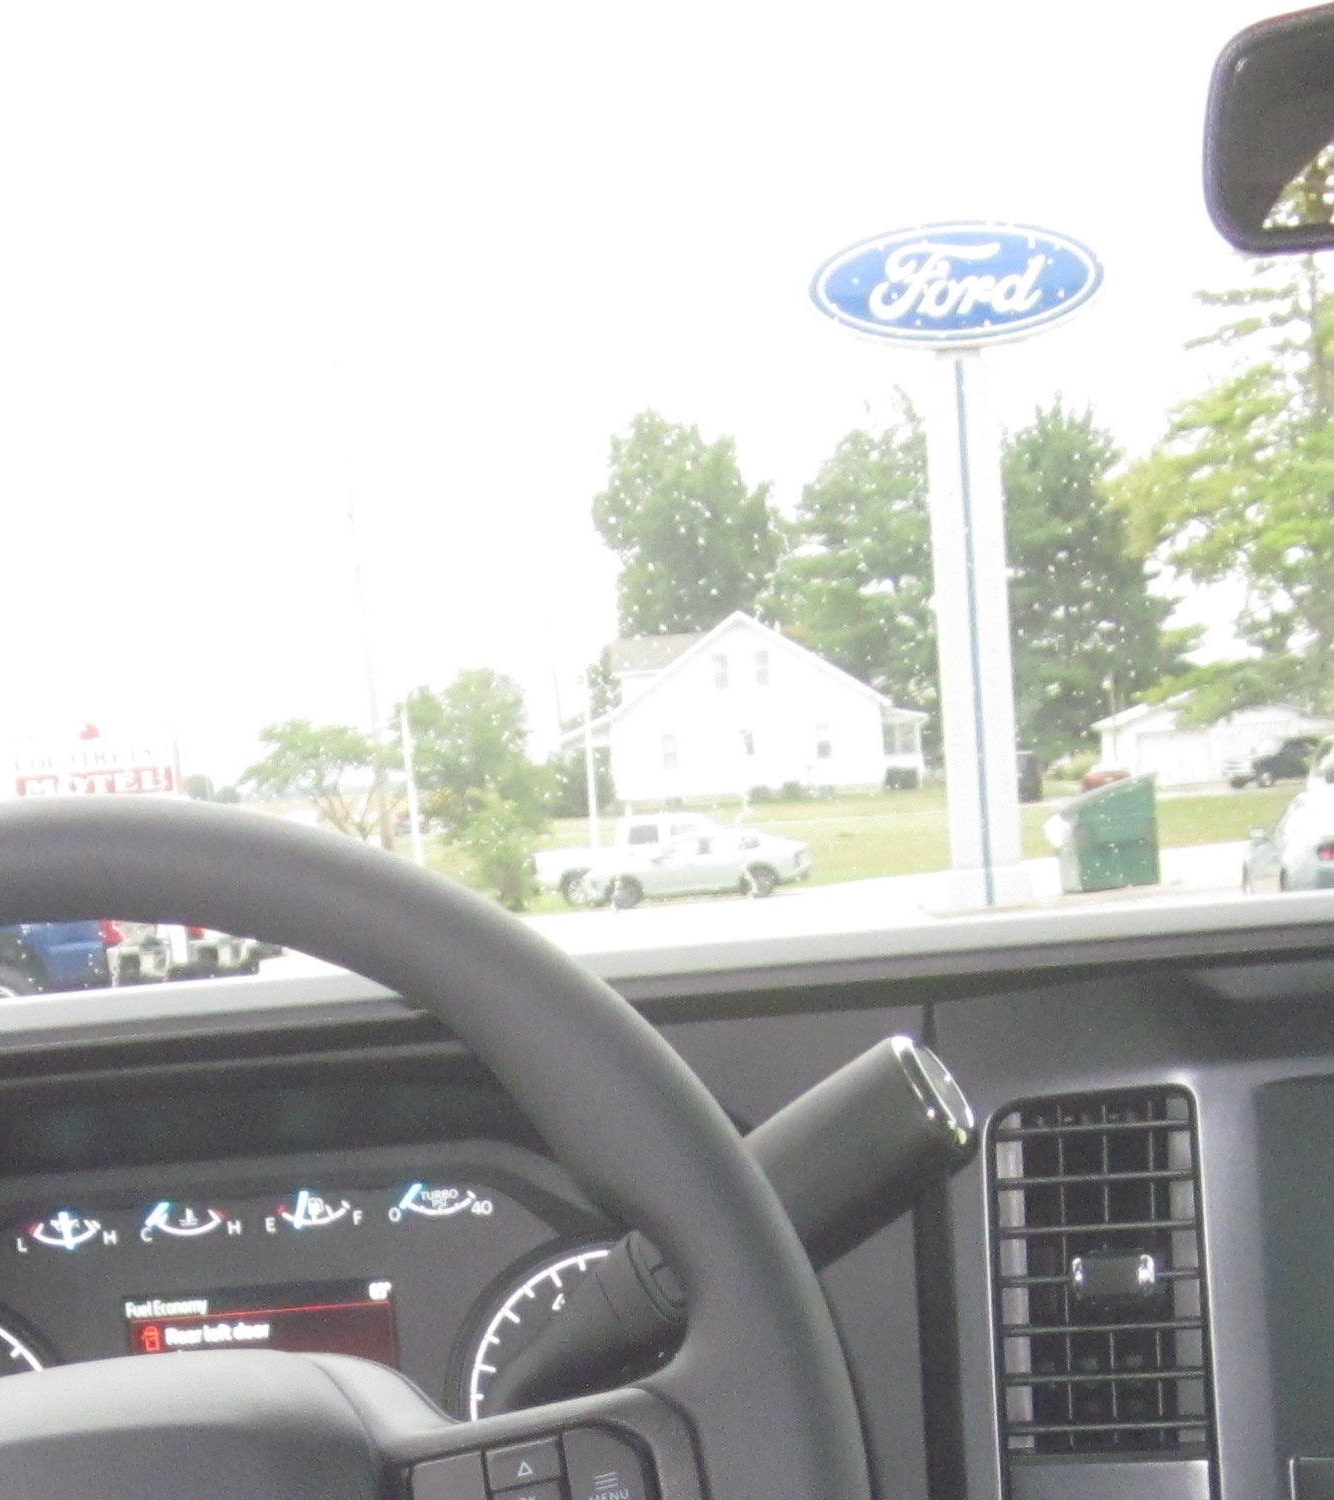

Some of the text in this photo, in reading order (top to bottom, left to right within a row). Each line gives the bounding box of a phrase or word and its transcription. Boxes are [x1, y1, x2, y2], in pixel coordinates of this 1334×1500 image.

[869, 240, 1046, 321] Ford
[421, 1188, 459, 1201] TURBO
[470, 1200, 494, 1216] 40
[265, 1217, 277, 1233] E
[352, 1210, 363, 1226] F
[140, 1227, 154, 1243] C
[227, 1220, 242, 1236] H
[16, 1237, 28, 1253] L
[103, 1230, 118, 1246] H
[125, 1298, 208, 1318] Fuel Economy
[165, 1321, 270, 1345] Rear left door
